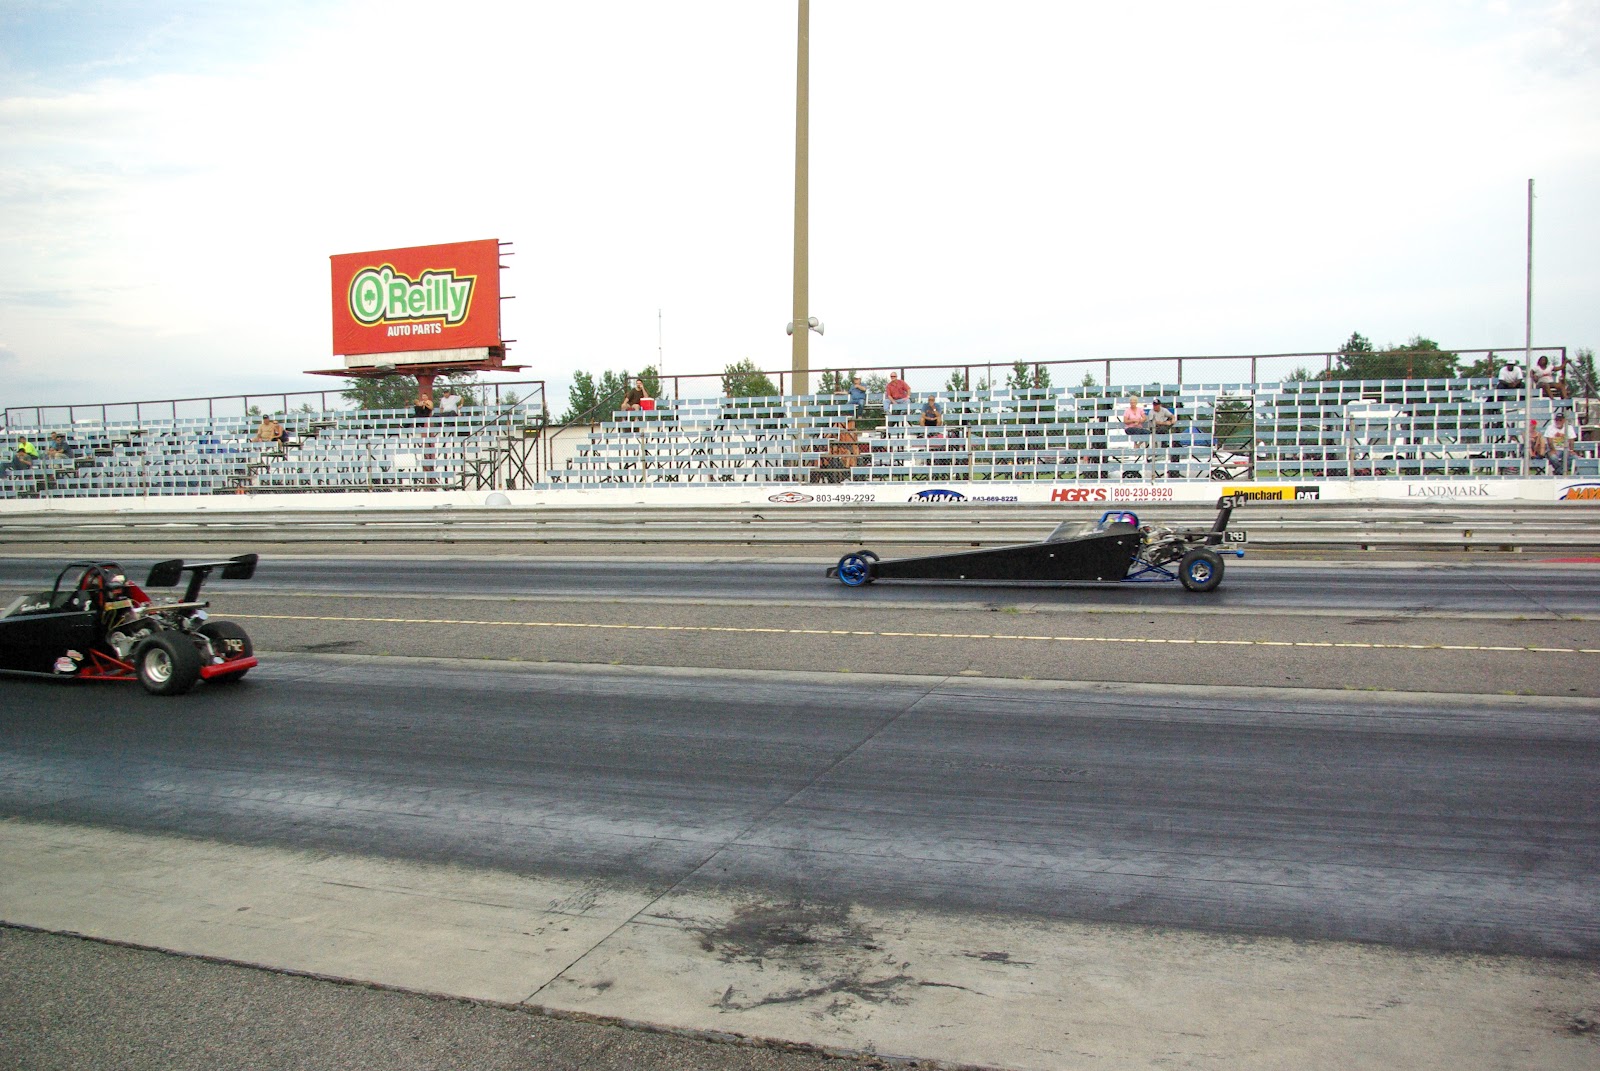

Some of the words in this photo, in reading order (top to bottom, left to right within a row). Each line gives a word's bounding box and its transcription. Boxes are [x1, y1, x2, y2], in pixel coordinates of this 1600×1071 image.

[355, 272, 466, 318] O'Reilly
[387, 324, 411, 337] AUTO
[412, 322, 442, 335] PARTS
[816, 494, 876, 502] 803-499-2292
[1051, 488, 1107, 502] HGR'S
[1114, 488, 1173, 497] 800-230-8920
[1297, 491, 1319, 500] CAT
[1222, 496, 1246, 508] 514
